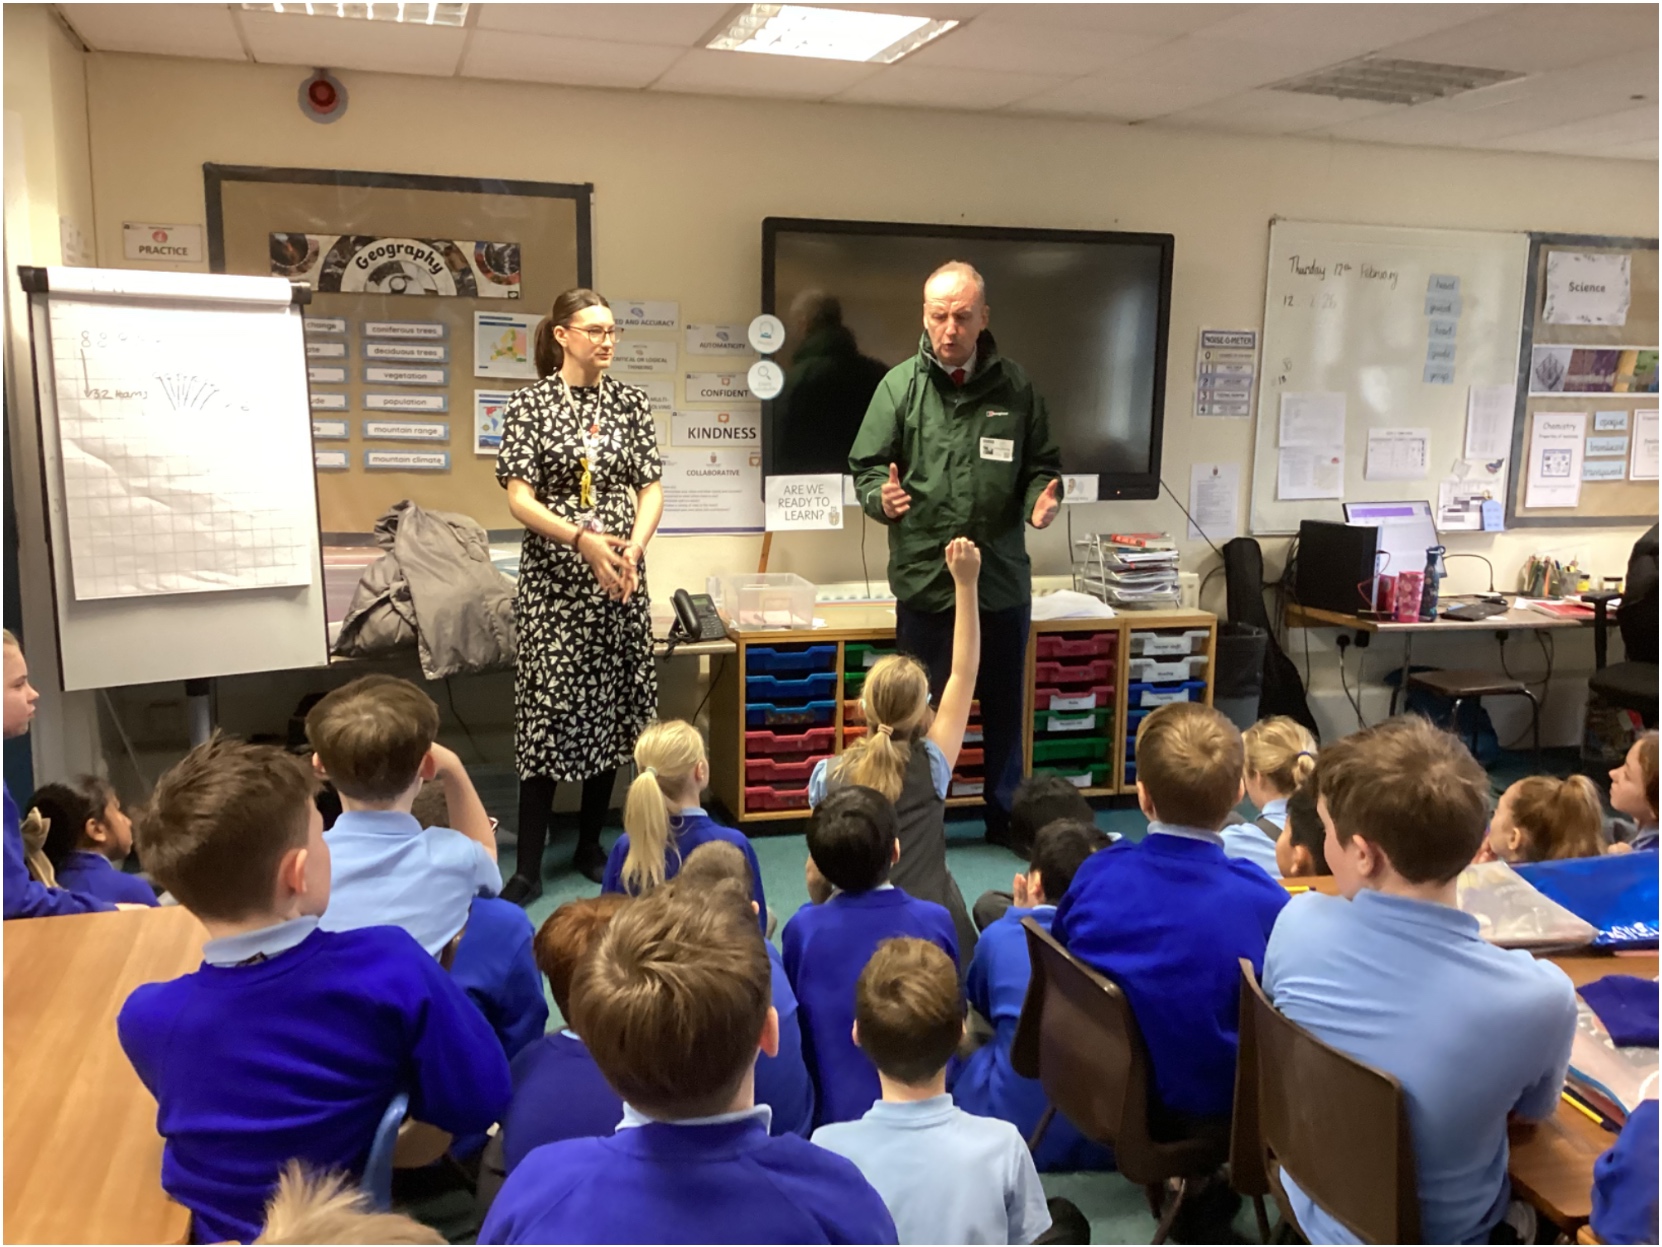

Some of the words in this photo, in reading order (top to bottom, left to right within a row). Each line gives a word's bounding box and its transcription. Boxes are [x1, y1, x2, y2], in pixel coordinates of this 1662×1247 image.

[138, 245, 188, 256] PRACTICE
[355, 243, 444, 276] Geography
[1289, 255, 1326, 281] Thursday
[1568, 281, 1606, 294] Science
[306, 322, 337, 331] change
[641, 319, 675, 327] ACCURACY
[372, 325, 412, 336] coniferous
[414, 327, 437, 336] trees
[374, 346, 415, 356] deciduous
[417, 348, 437, 357] trees
[699, 342, 746, 350] AUTOMATICITY
[384, 371, 428, 382] vegetation
[700, 388, 749, 398] CONFIDENT
[383, 397, 428, 408] population
[373, 426, 413, 435] mountain
[414, 427, 438, 437] range
[1542, 420, 1577, 432] Chemistry
[687, 427, 757, 440] KINDNESS
[372, 455, 411, 464] mountain
[412, 455, 442, 465] climate
[686, 469, 740, 477] COLLABORATIVE
[783, 484, 805, 495] ARE
[806, 483, 825, 495] WE
[778, 496, 814, 508] READY
[815, 496, 831, 508] TO
[784, 509, 825, 522] LEARN?
